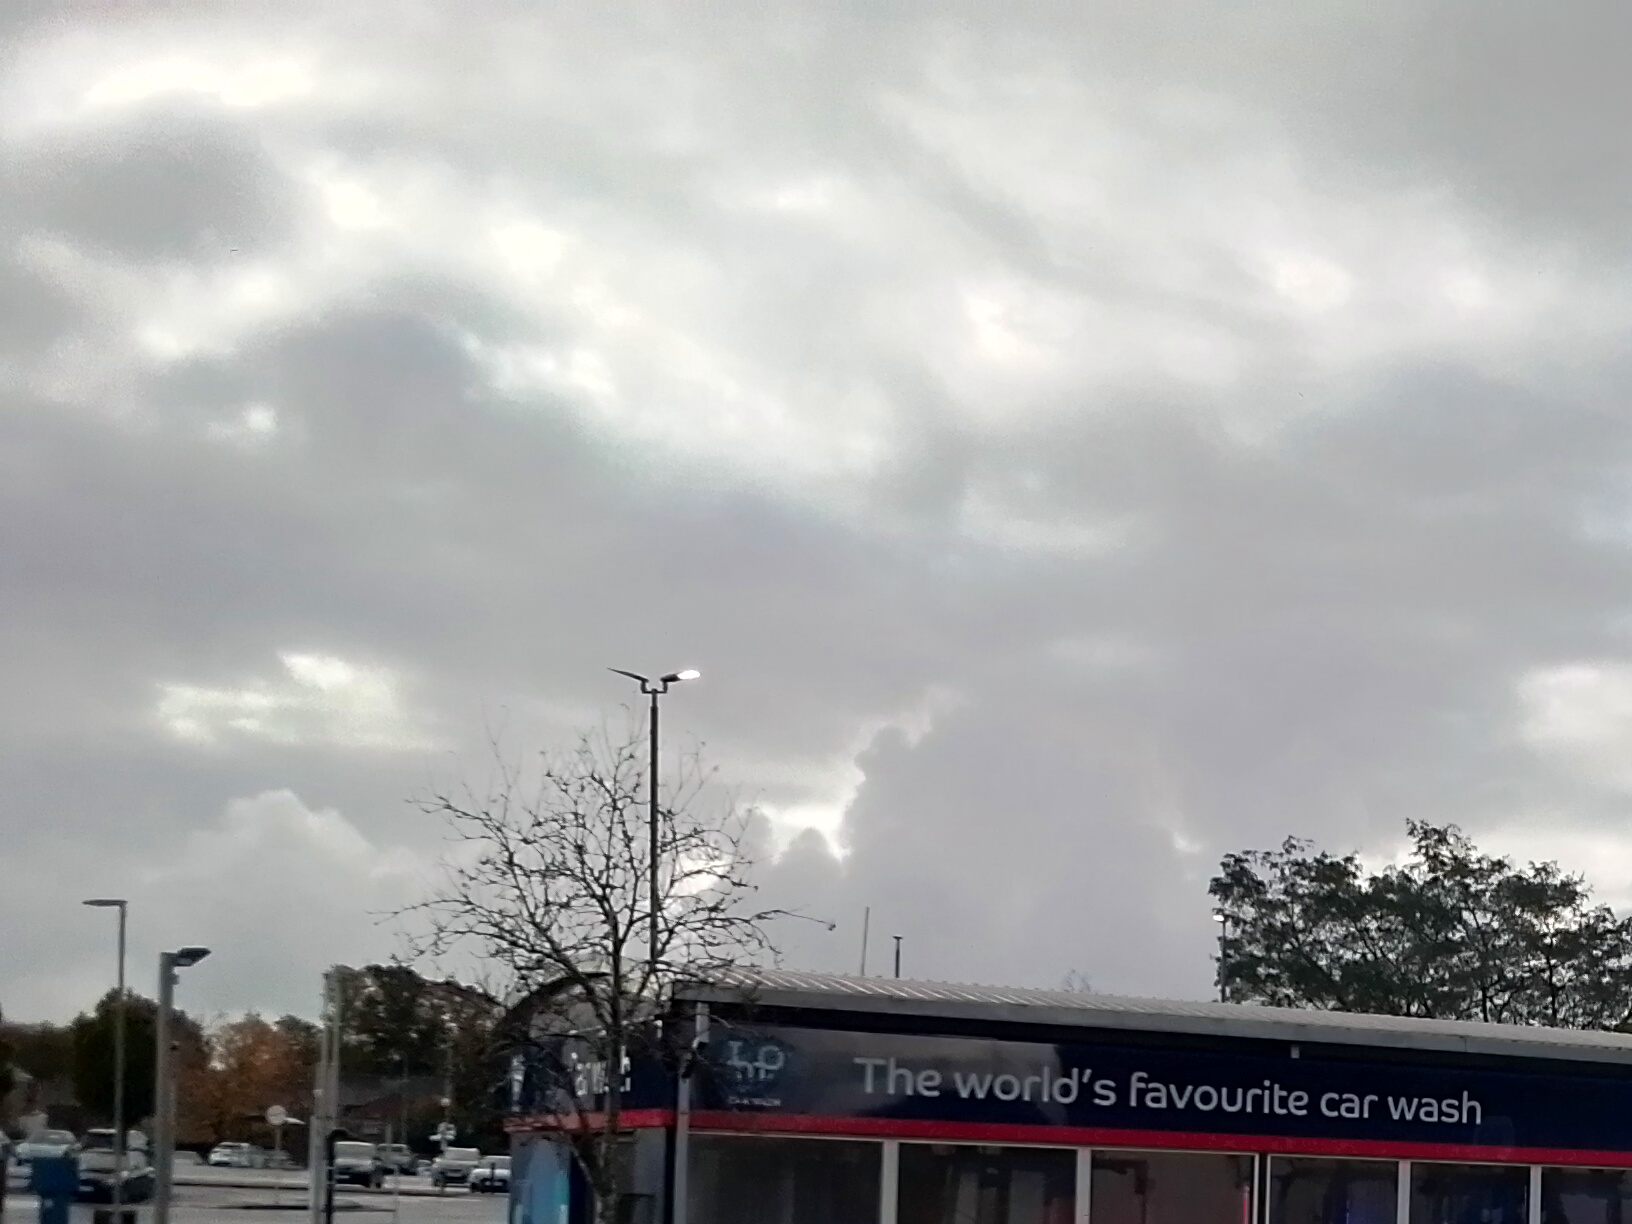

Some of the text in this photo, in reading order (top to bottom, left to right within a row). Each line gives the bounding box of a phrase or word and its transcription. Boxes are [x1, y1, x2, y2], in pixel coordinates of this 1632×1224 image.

[854, 1056, 1483, 1126] The world's favourite car wash
